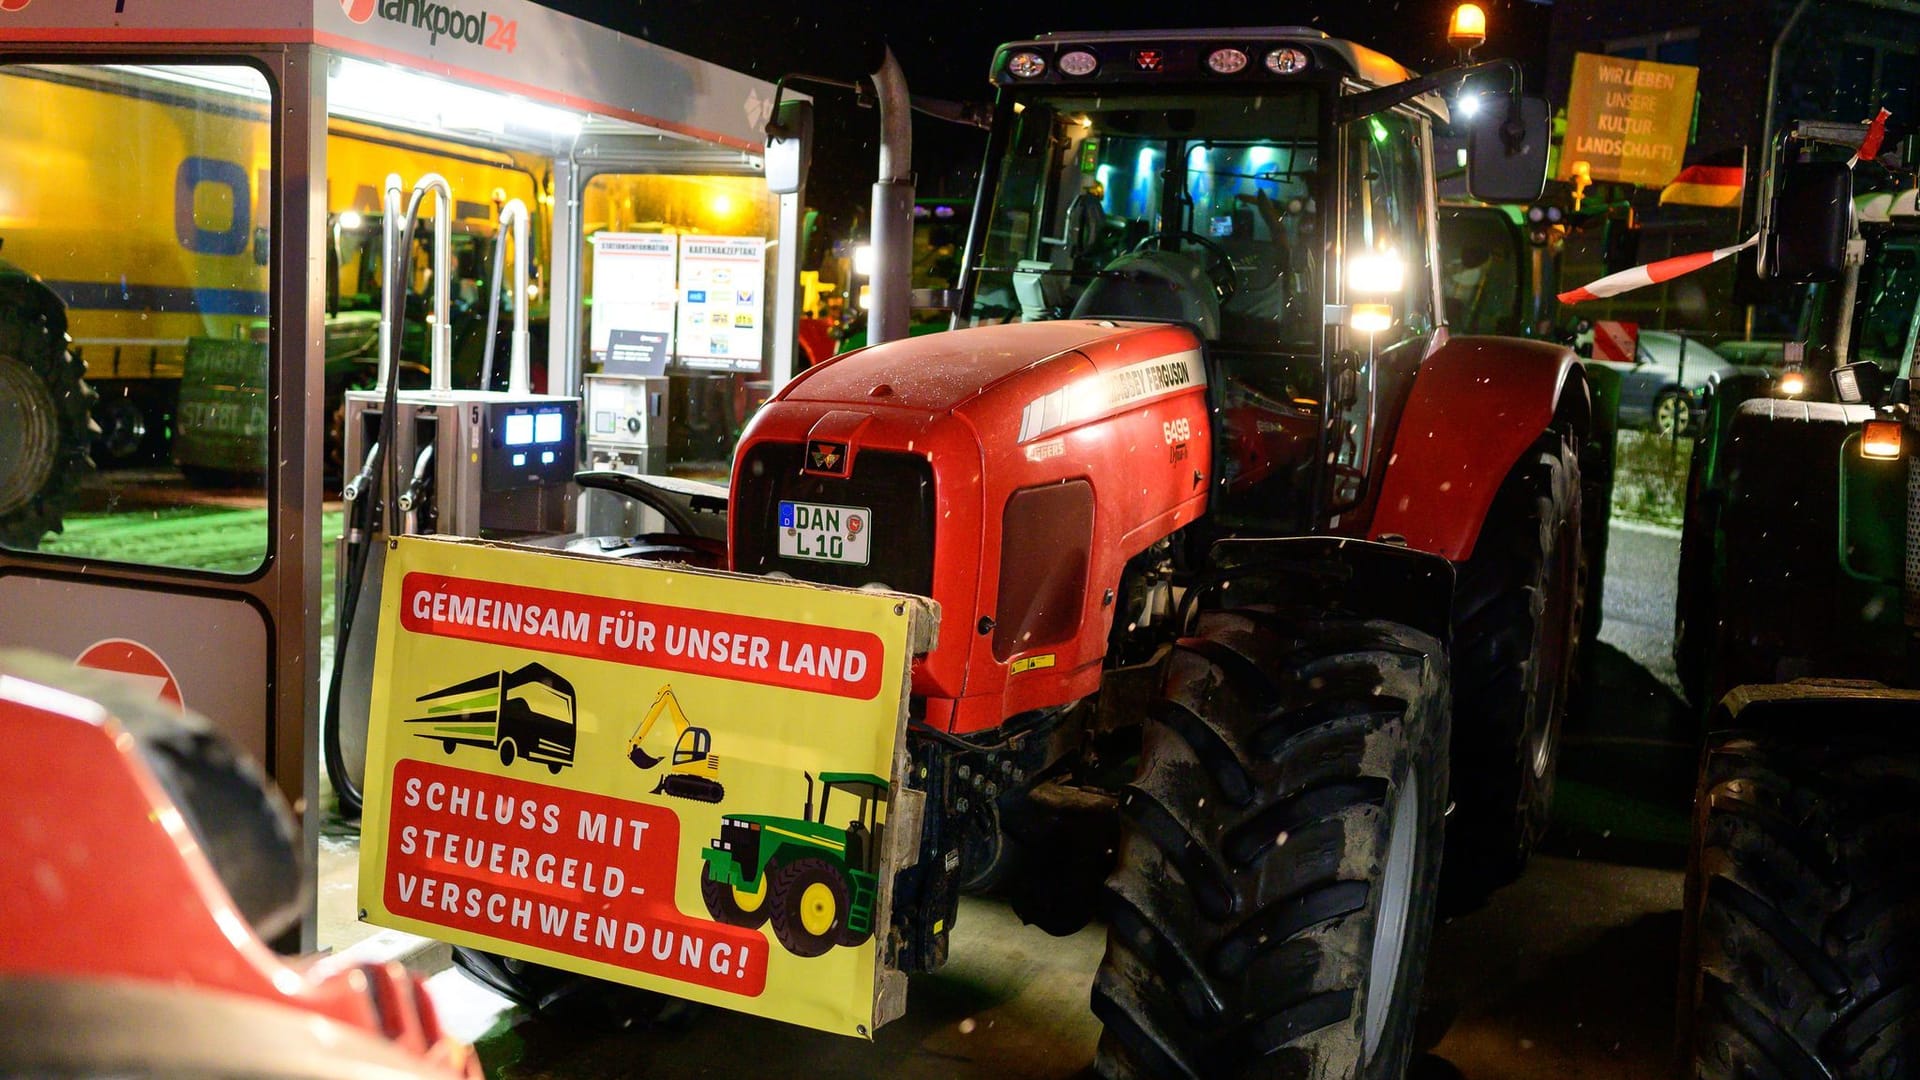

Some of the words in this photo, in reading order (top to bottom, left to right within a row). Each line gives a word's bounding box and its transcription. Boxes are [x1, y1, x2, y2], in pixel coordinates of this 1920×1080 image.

[1599, 66, 1623, 83] WIR
[1624, 68, 1676, 91] LIEBEN
[1606, 91, 1657, 111] UNSERE
[1597, 114, 1657, 135] KULTUR-
[688, 245, 758, 256] KARTENAKZEPTANZ
[1148, 361, 1190, 389] FERGUSON
[472, 405, 479, 424] 5
[1163, 417, 1190, 445] 6499
[784, 518, 790, 526] D
[796, 506, 839, 532] DAN
[797, 532, 810, 556] L
[815, 534, 843, 558] 10
[412, 590, 590, 643] GEMEINSAM
[598, 609, 656, 652] FÜR
[665, 627, 770, 669] UNSER
[778, 640, 867, 683] LAND
[404, 777, 561, 835] SCHLUSS
[577, 810, 650, 850] MIT
[400, 825, 645, 898] STEUERGELD-
[397, 872, 750, 979] VERSCHWENDUNG!
